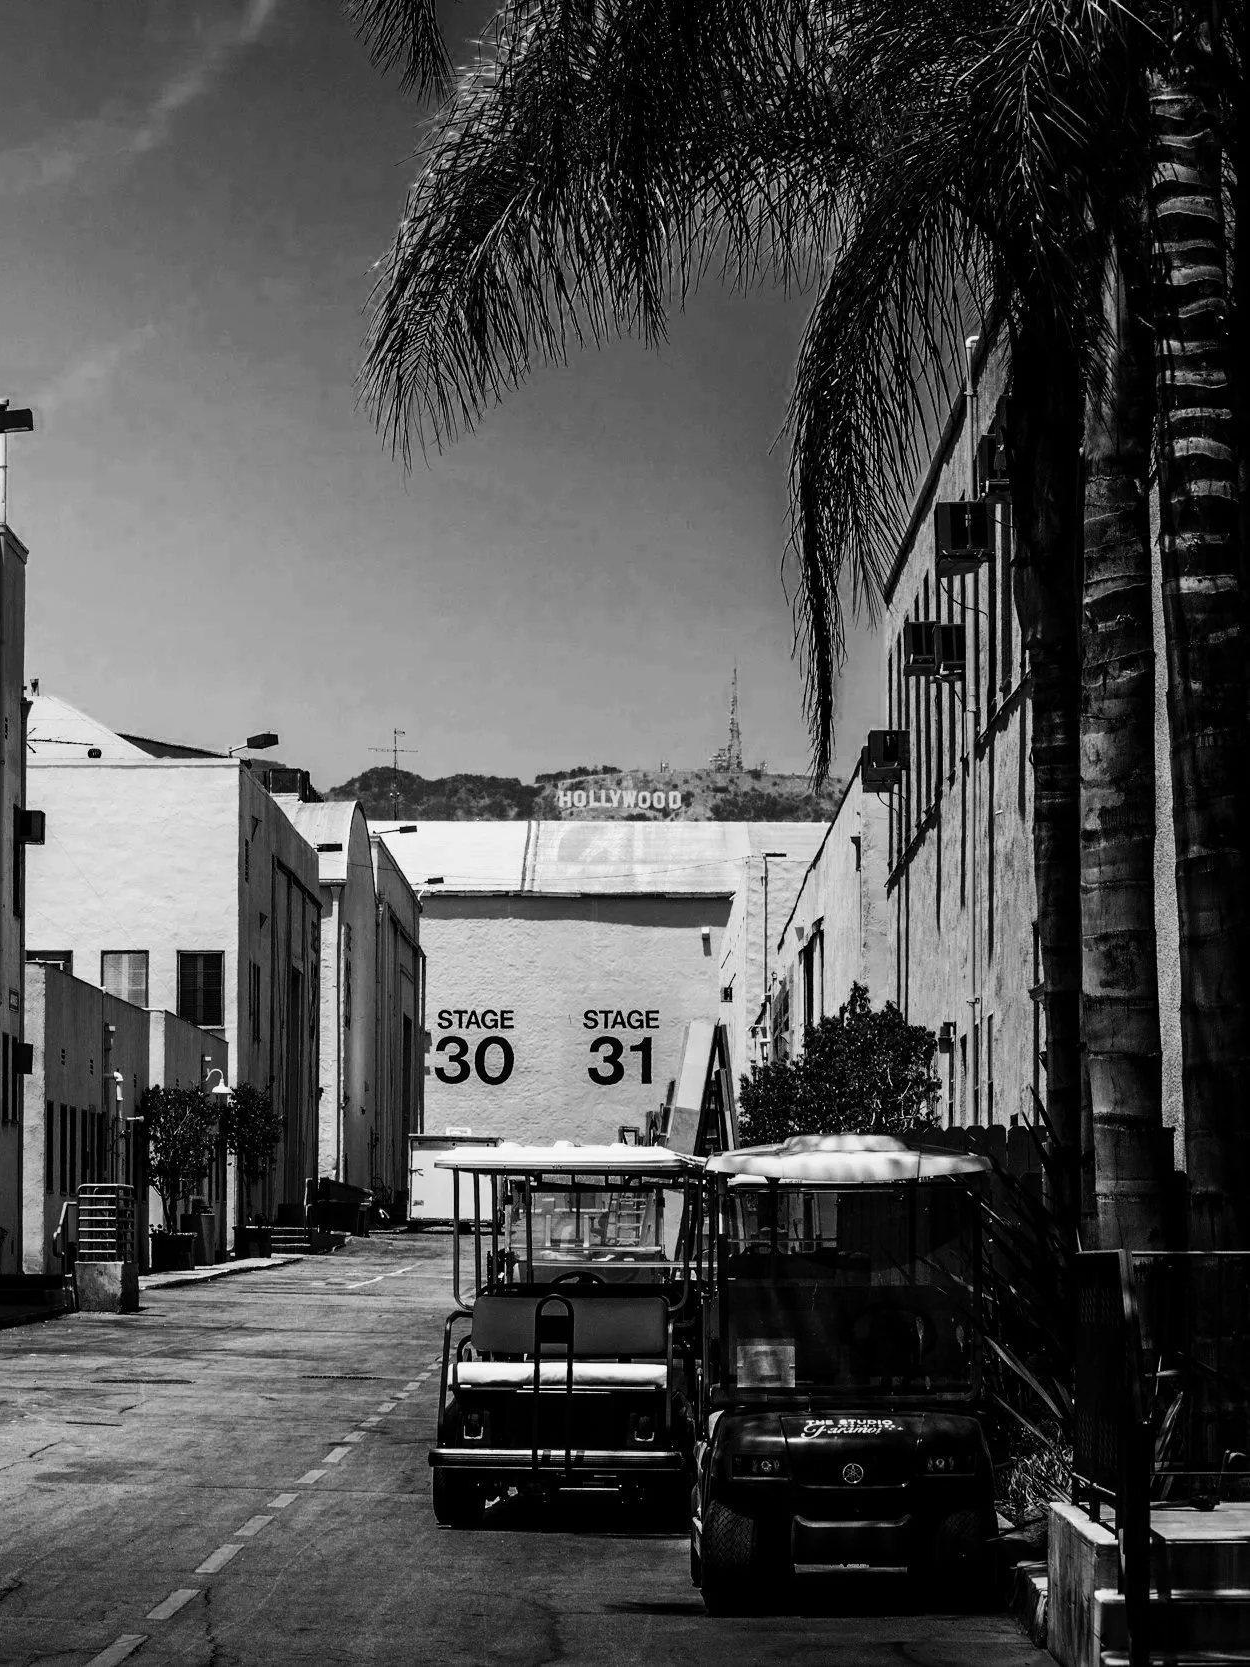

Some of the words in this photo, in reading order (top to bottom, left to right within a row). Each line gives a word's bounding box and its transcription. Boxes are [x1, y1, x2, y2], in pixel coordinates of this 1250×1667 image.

[557, 789, 682, 809] HOLLYWOOD
[437, 1009, 515, 1029] STAGE
[583, 1009, 660, 1030] STAGE
[434, 1035, 515, 1086] 30
[588, 1035, 652, 1085] 31
